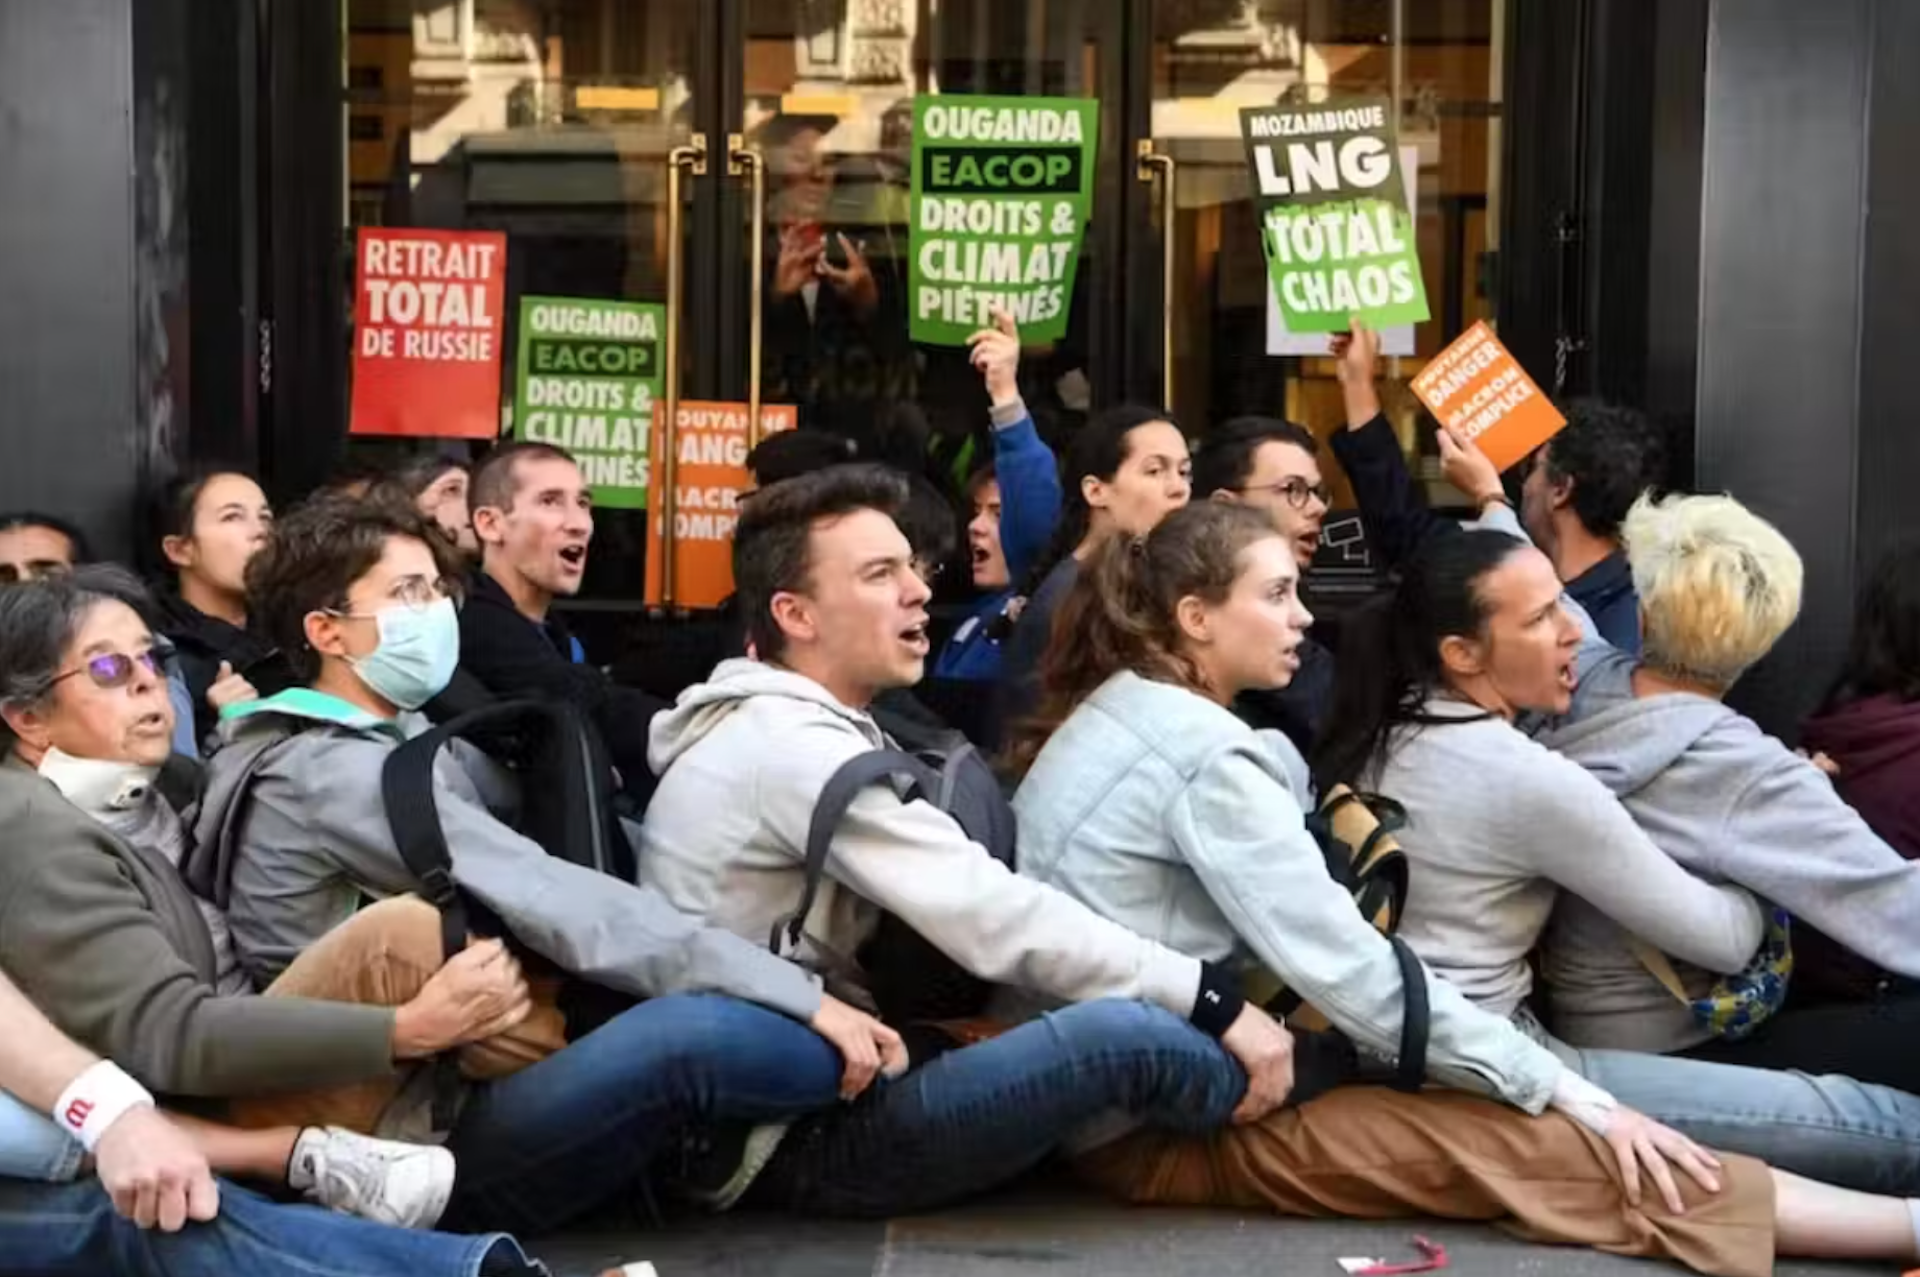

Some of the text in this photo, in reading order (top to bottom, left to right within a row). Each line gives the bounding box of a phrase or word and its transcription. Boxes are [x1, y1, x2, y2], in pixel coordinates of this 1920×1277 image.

[923, 105, 1083, 143] OUGANDA
[1250, 105, 1383, 136] MOZAMBIQUE
[931, 154, 1072, 186] EACOP
[1253, 135, 1391, 195] LNG
[920, 197, 1075, 235] DROITS &
[1265, 206, 1406, 263] TOTAL
[365, 238, 495, 279] RETRAIT
[918, 239, 1073, 284] CLIMAT
[365, 279, 493, 327] TOTAL
[1282, 260, 1415, 313] CHAOS
[530, 304, 657, 339] OUGANDA
[362, 328, 492, 361] DE RUSSIE
[536, 344, 649, 372] EACOP
[1427, 340, 1501, 407] DANGER
[527, 377, 654, 412] DROITS &
[525, 411, 651, 452] CLIMAT
